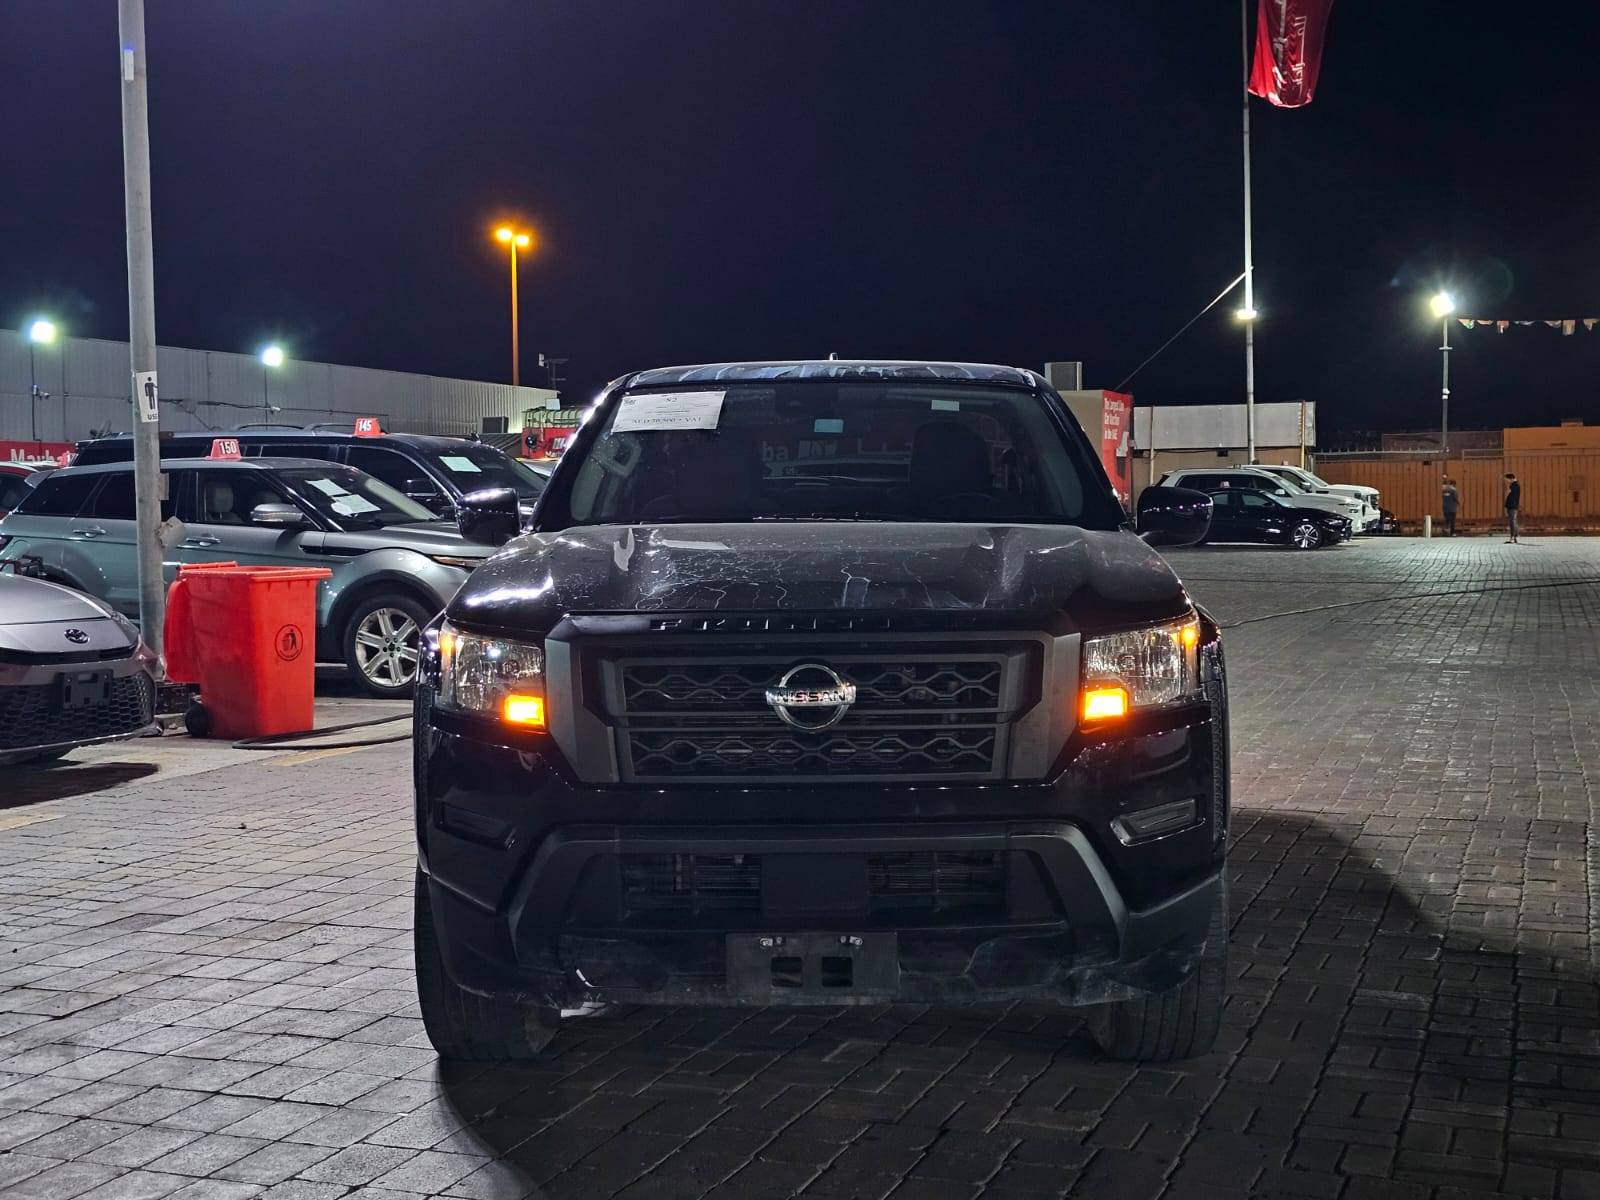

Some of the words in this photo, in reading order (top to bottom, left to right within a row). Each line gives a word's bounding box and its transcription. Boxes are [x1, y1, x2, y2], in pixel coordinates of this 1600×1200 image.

[358, 420, 372, 432] 145
[220, 441, 237, 454] 150
[776, 690, 847, 704] NISSAN
